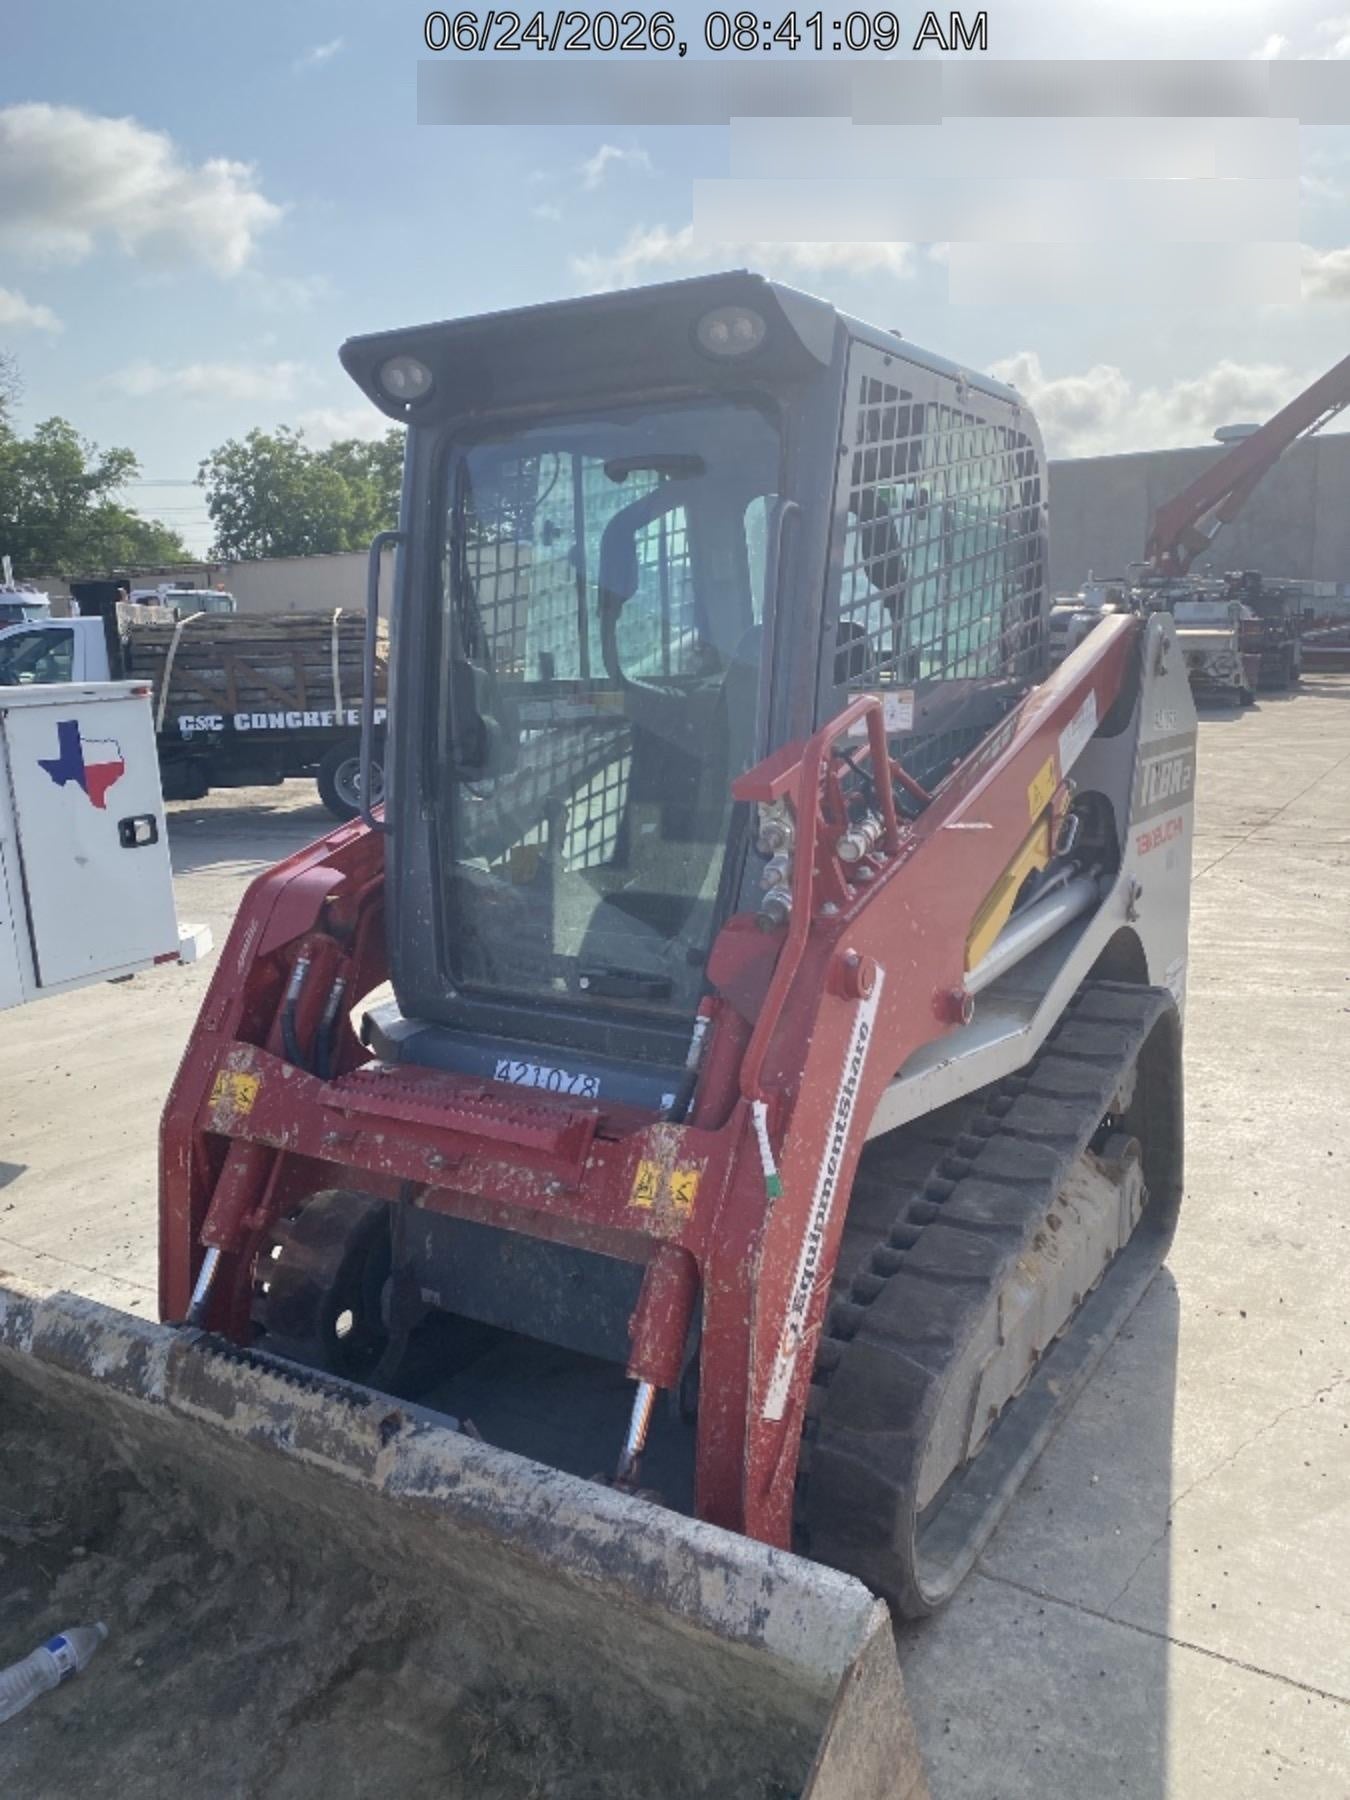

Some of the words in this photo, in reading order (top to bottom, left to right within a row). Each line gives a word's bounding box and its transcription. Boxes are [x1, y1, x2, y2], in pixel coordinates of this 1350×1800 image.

[178, 714, 225, 731] C&C
[495, 1060, 597, 1098] 421078
[790, 1018, 871, 1318] EquipmentShare
